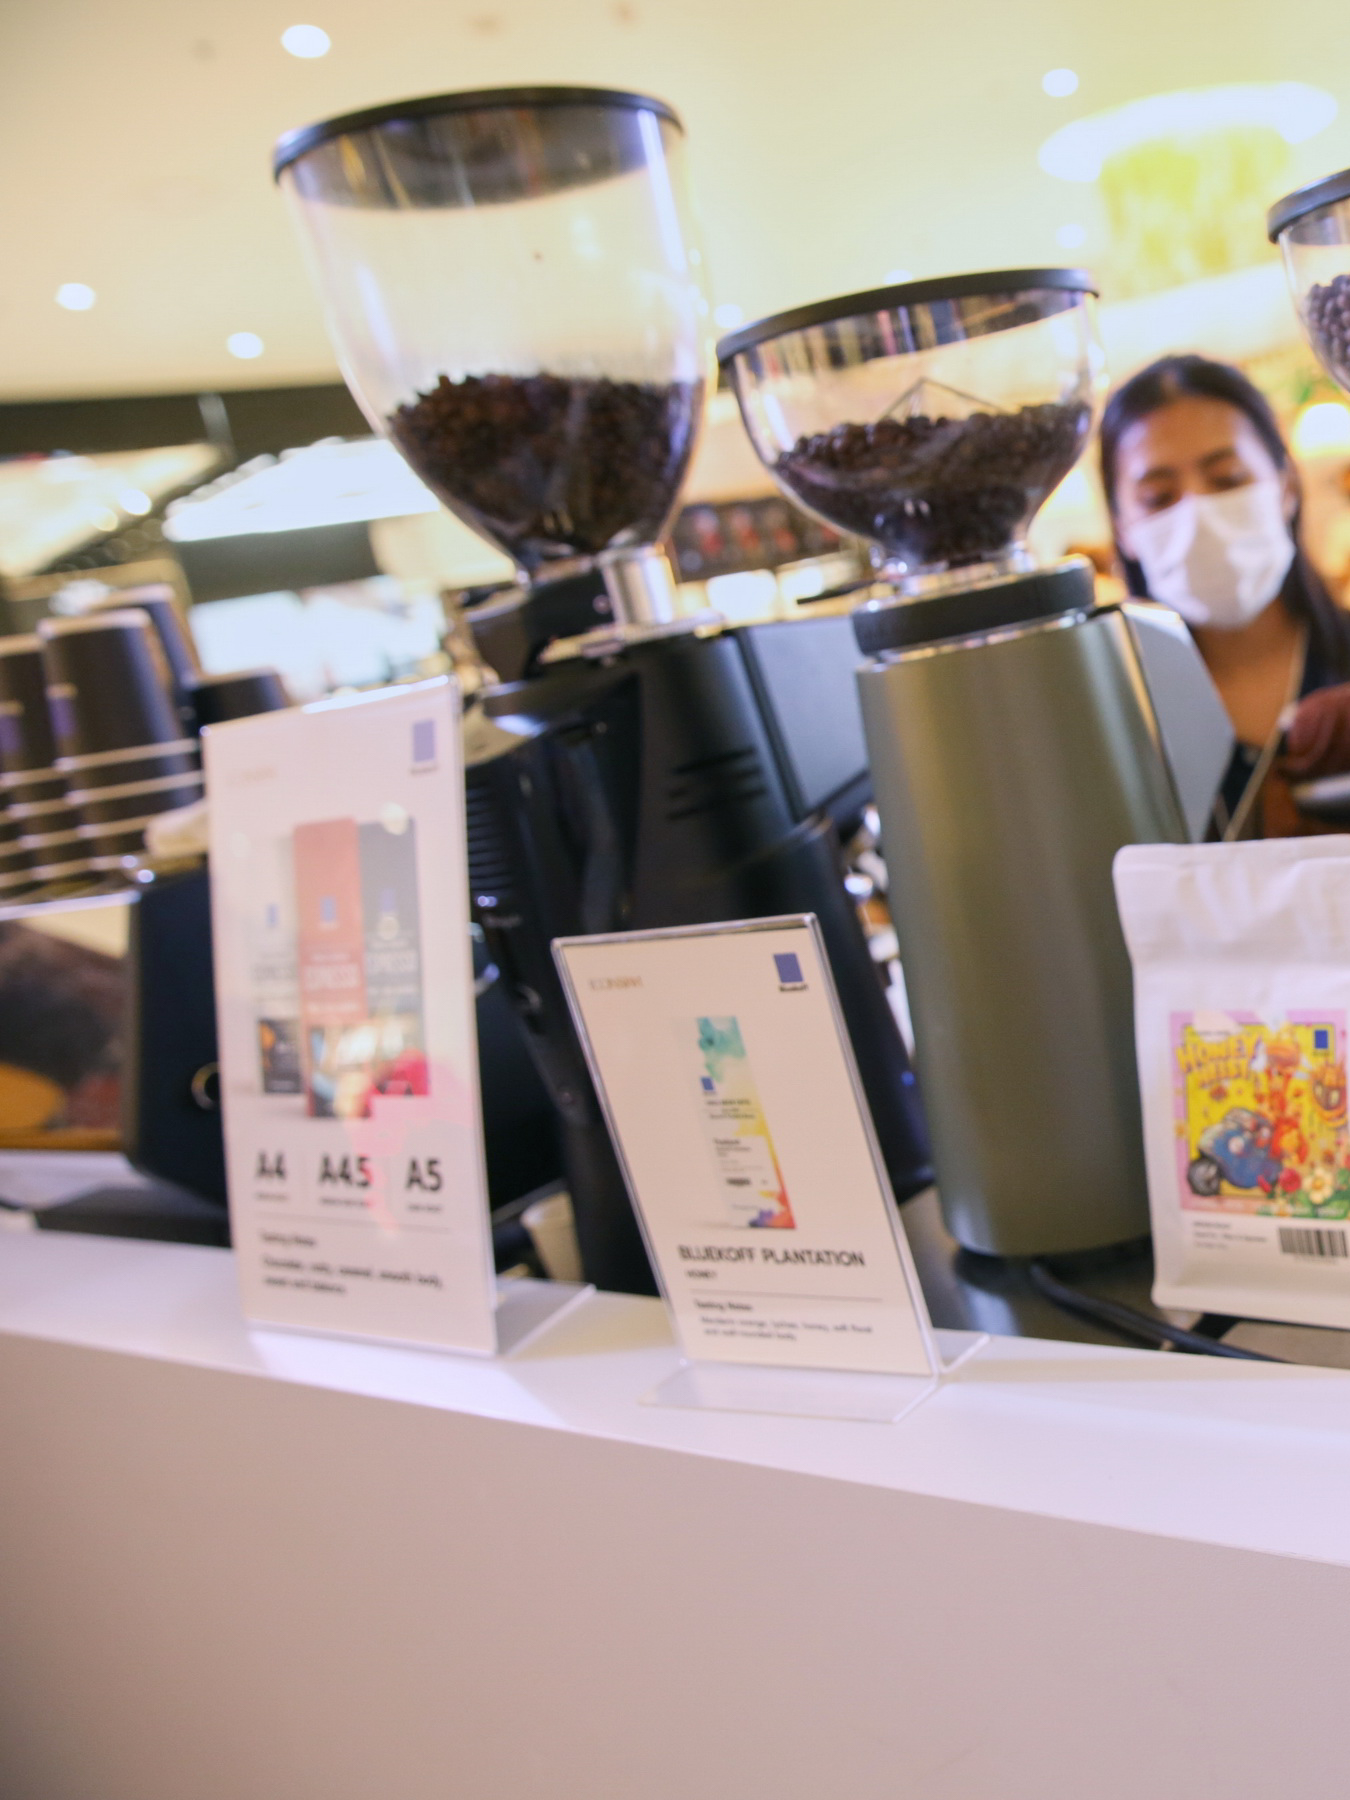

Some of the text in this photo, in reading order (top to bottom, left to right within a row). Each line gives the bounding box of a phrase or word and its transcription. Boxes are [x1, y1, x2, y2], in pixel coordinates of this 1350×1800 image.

[406, 1157, 443, 1192] A5
[677, 1244, 867, 1268] BLUEKOFF PLANTATION
